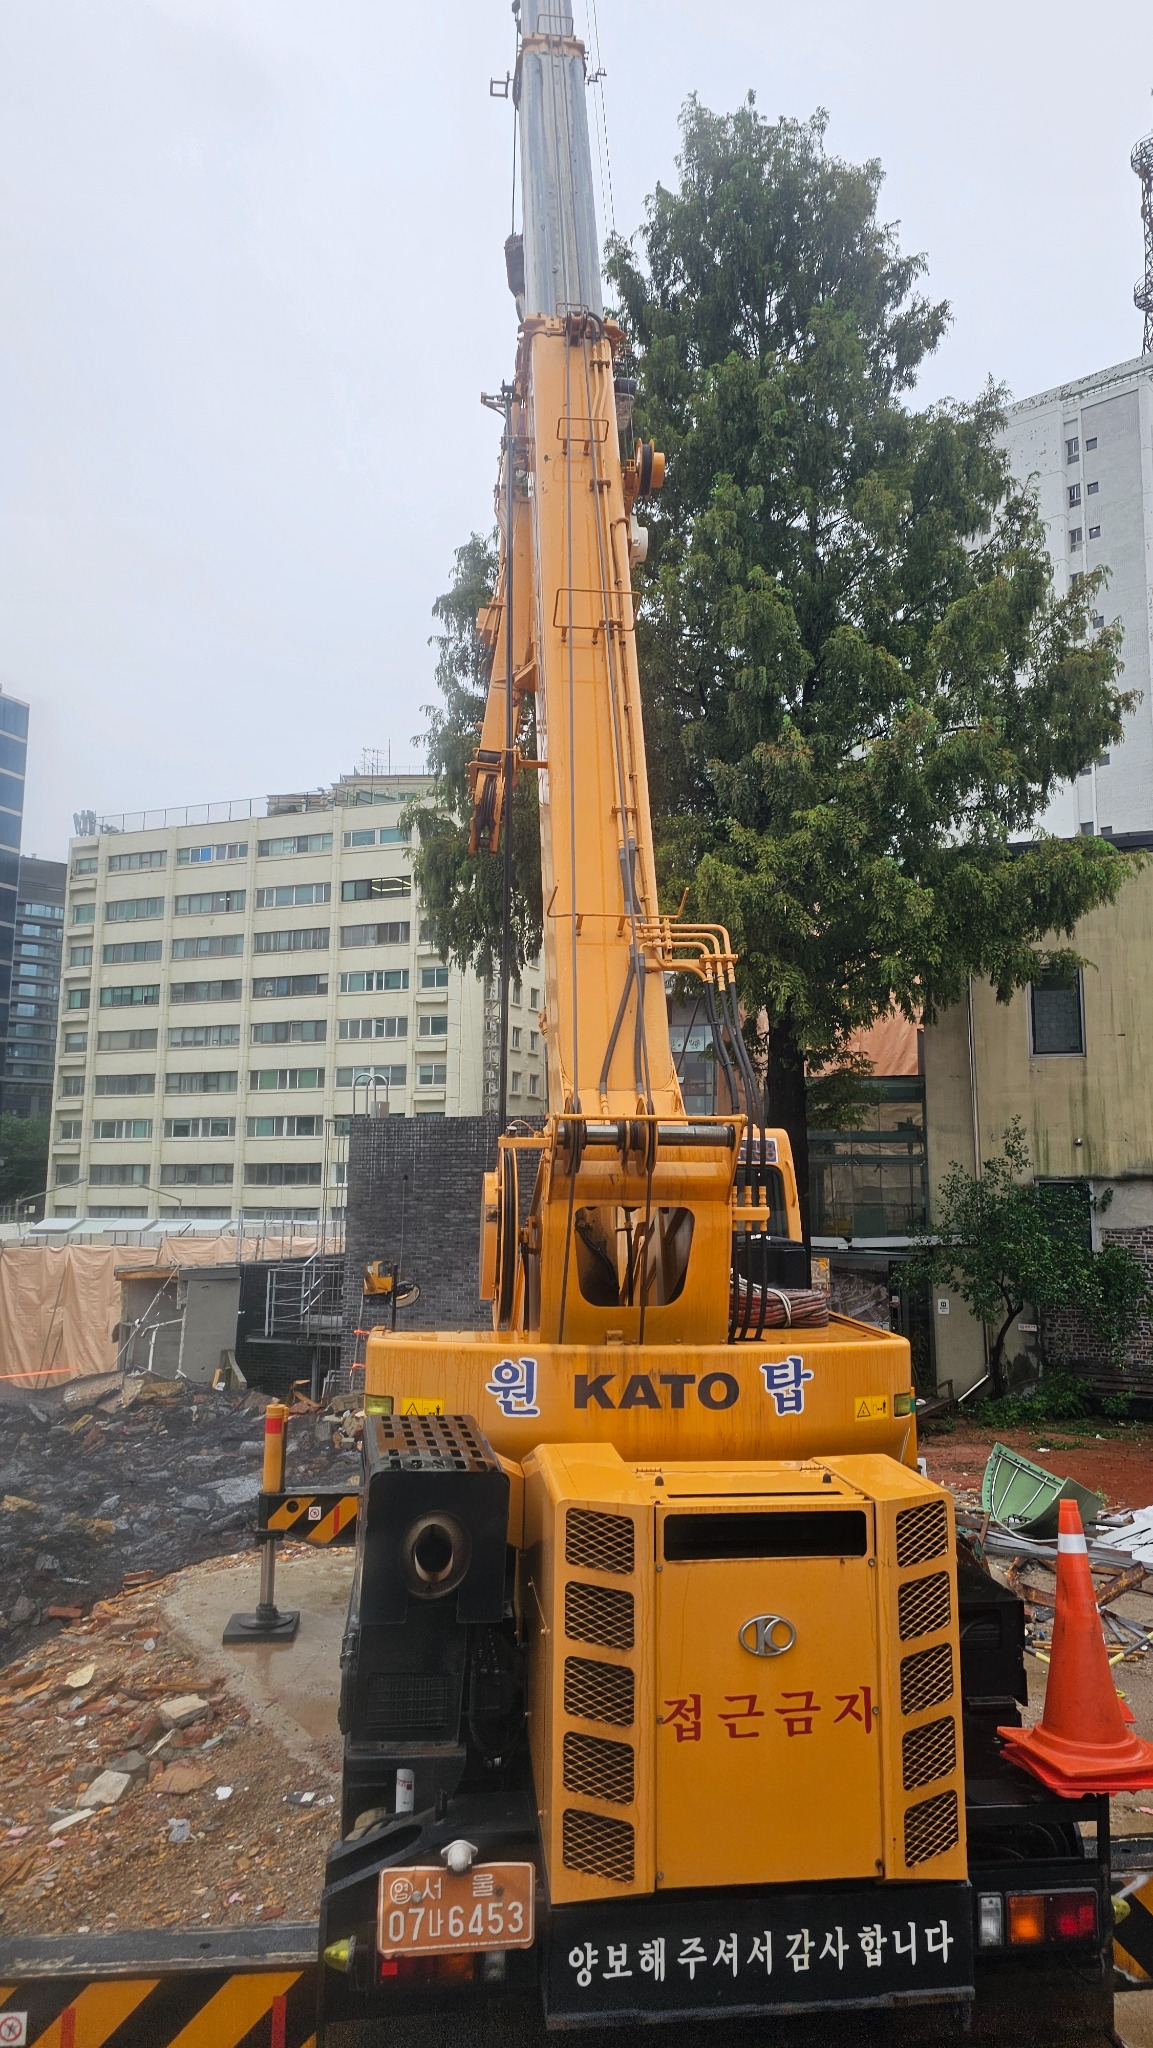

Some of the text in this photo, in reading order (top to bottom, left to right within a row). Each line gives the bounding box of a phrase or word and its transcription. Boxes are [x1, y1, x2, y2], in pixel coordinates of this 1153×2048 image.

[486, 1355, 814, 1417] 원 KATO 탑
[662, 1686, 872, 1743] 접근금지
[388, 1901, 524, 1942] 07나6453
[568, 1919, 954, 1987] 양보해 주셔서 감사합니다
